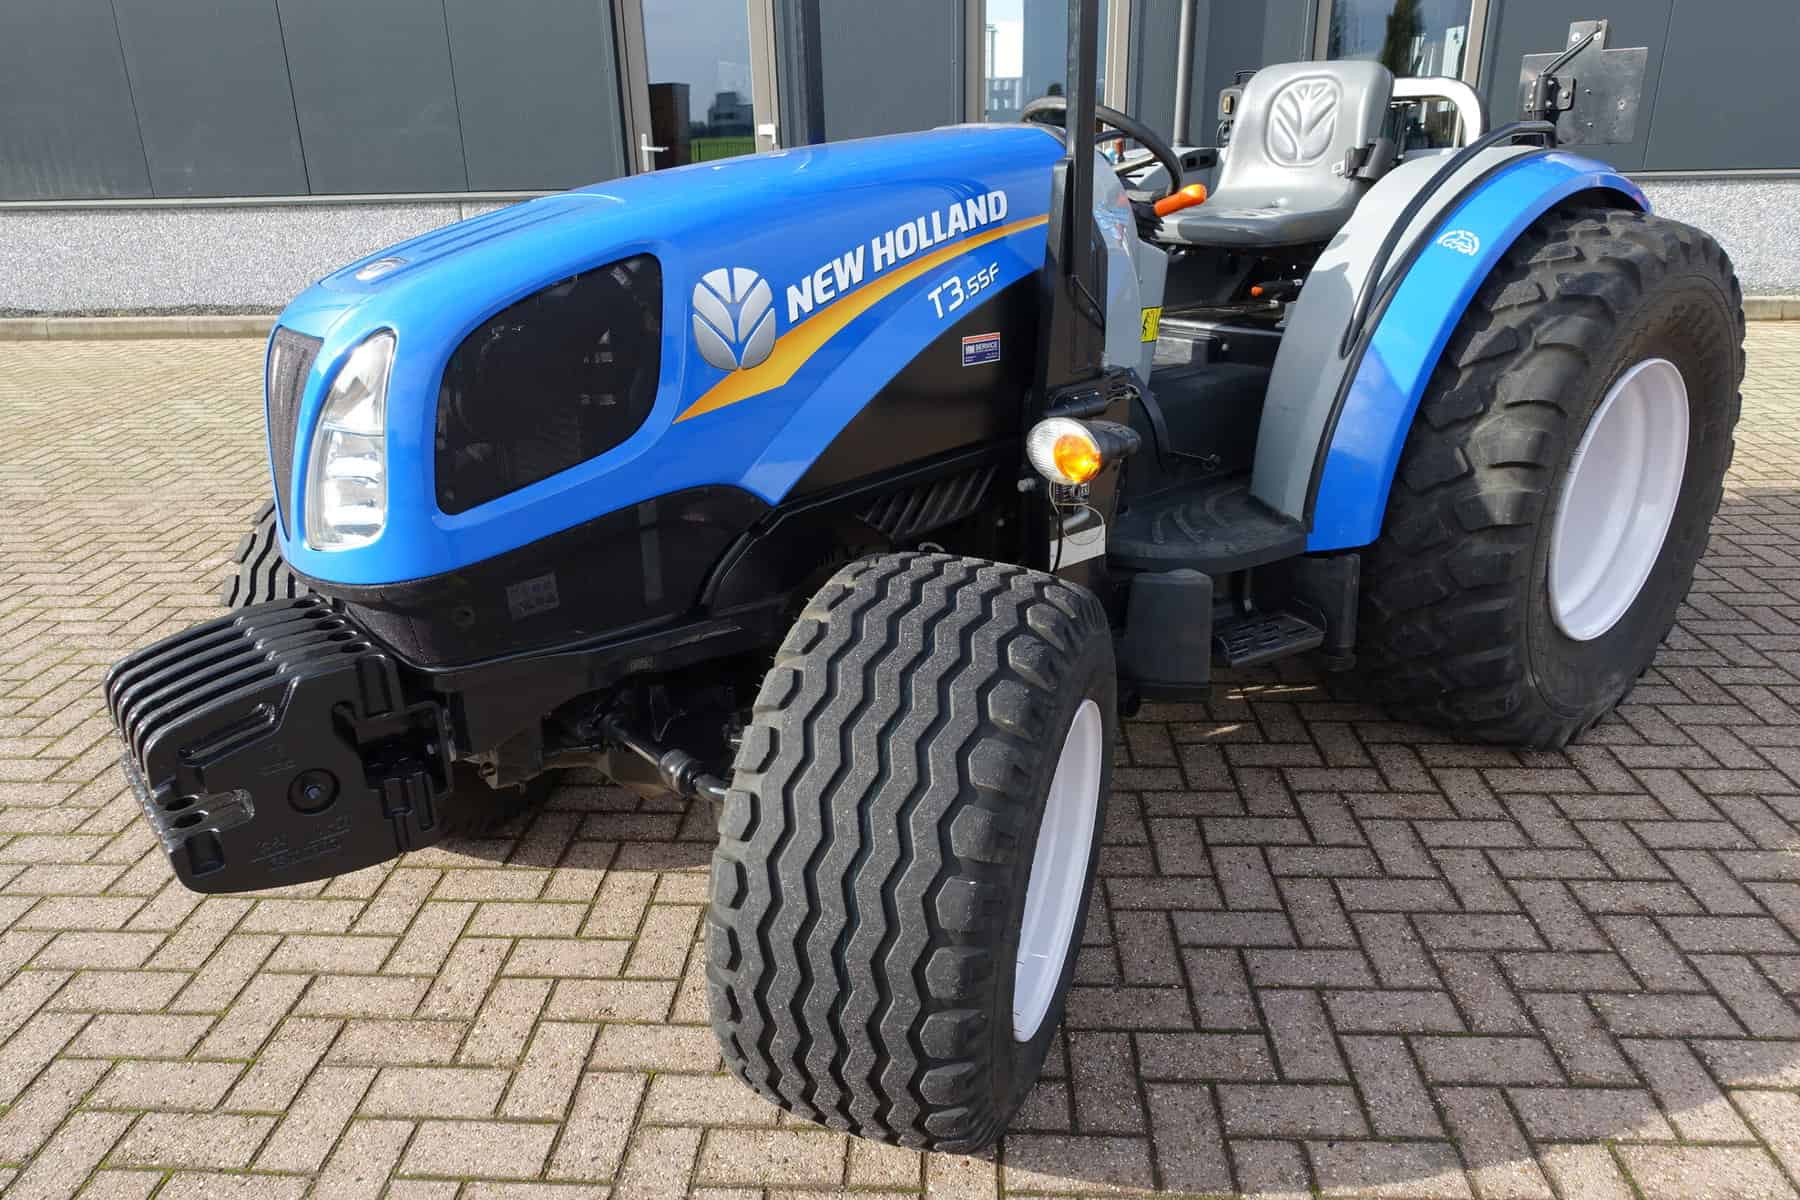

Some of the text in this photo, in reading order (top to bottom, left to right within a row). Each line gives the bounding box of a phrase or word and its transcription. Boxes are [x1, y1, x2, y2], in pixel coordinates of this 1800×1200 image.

[786, 190, 1008, 323] NEW HOLLAND
[928, 261, 999, 319] T3.55F
